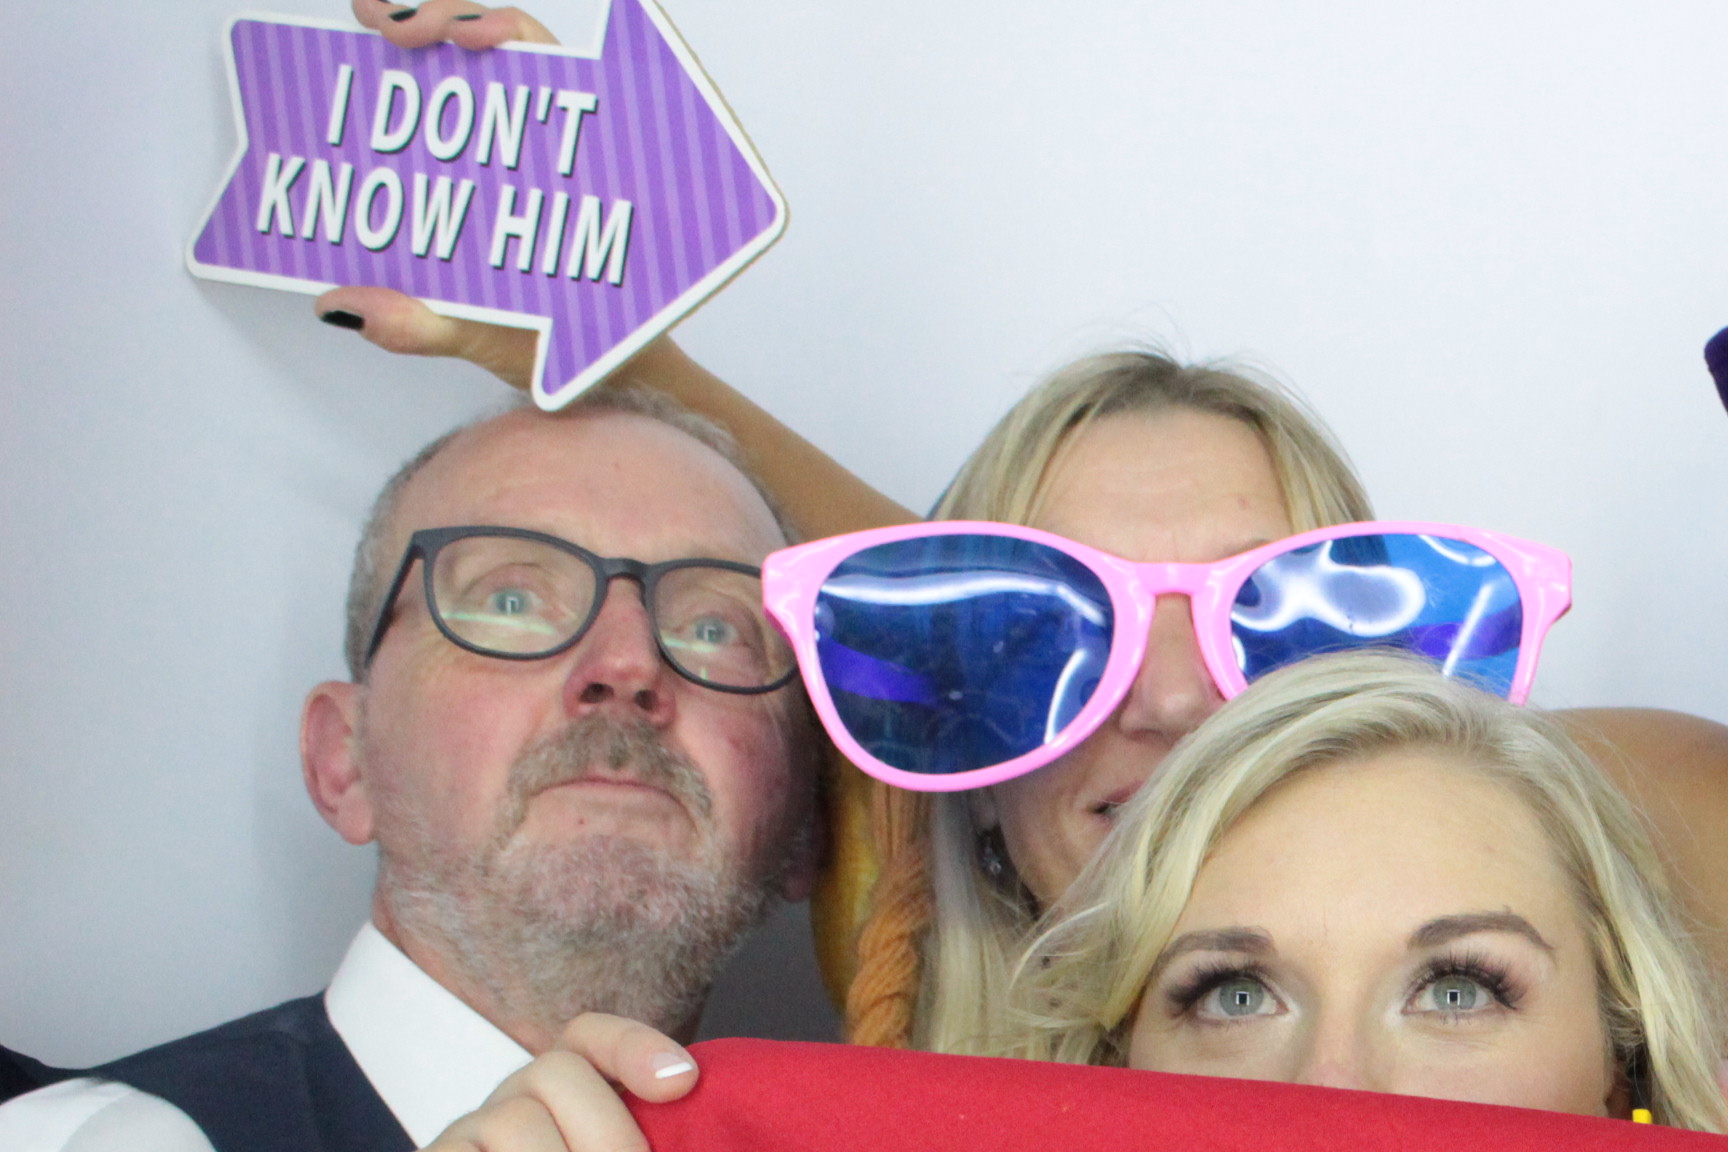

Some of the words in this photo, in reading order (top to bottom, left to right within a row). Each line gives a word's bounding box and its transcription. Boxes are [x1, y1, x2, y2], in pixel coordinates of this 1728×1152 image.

[326, 63, 355, 146] I
[369, 69, 599, 177] DON'T
[255, 152, 477, 260] KNOW
[488, 183, 634, 285] HIM
